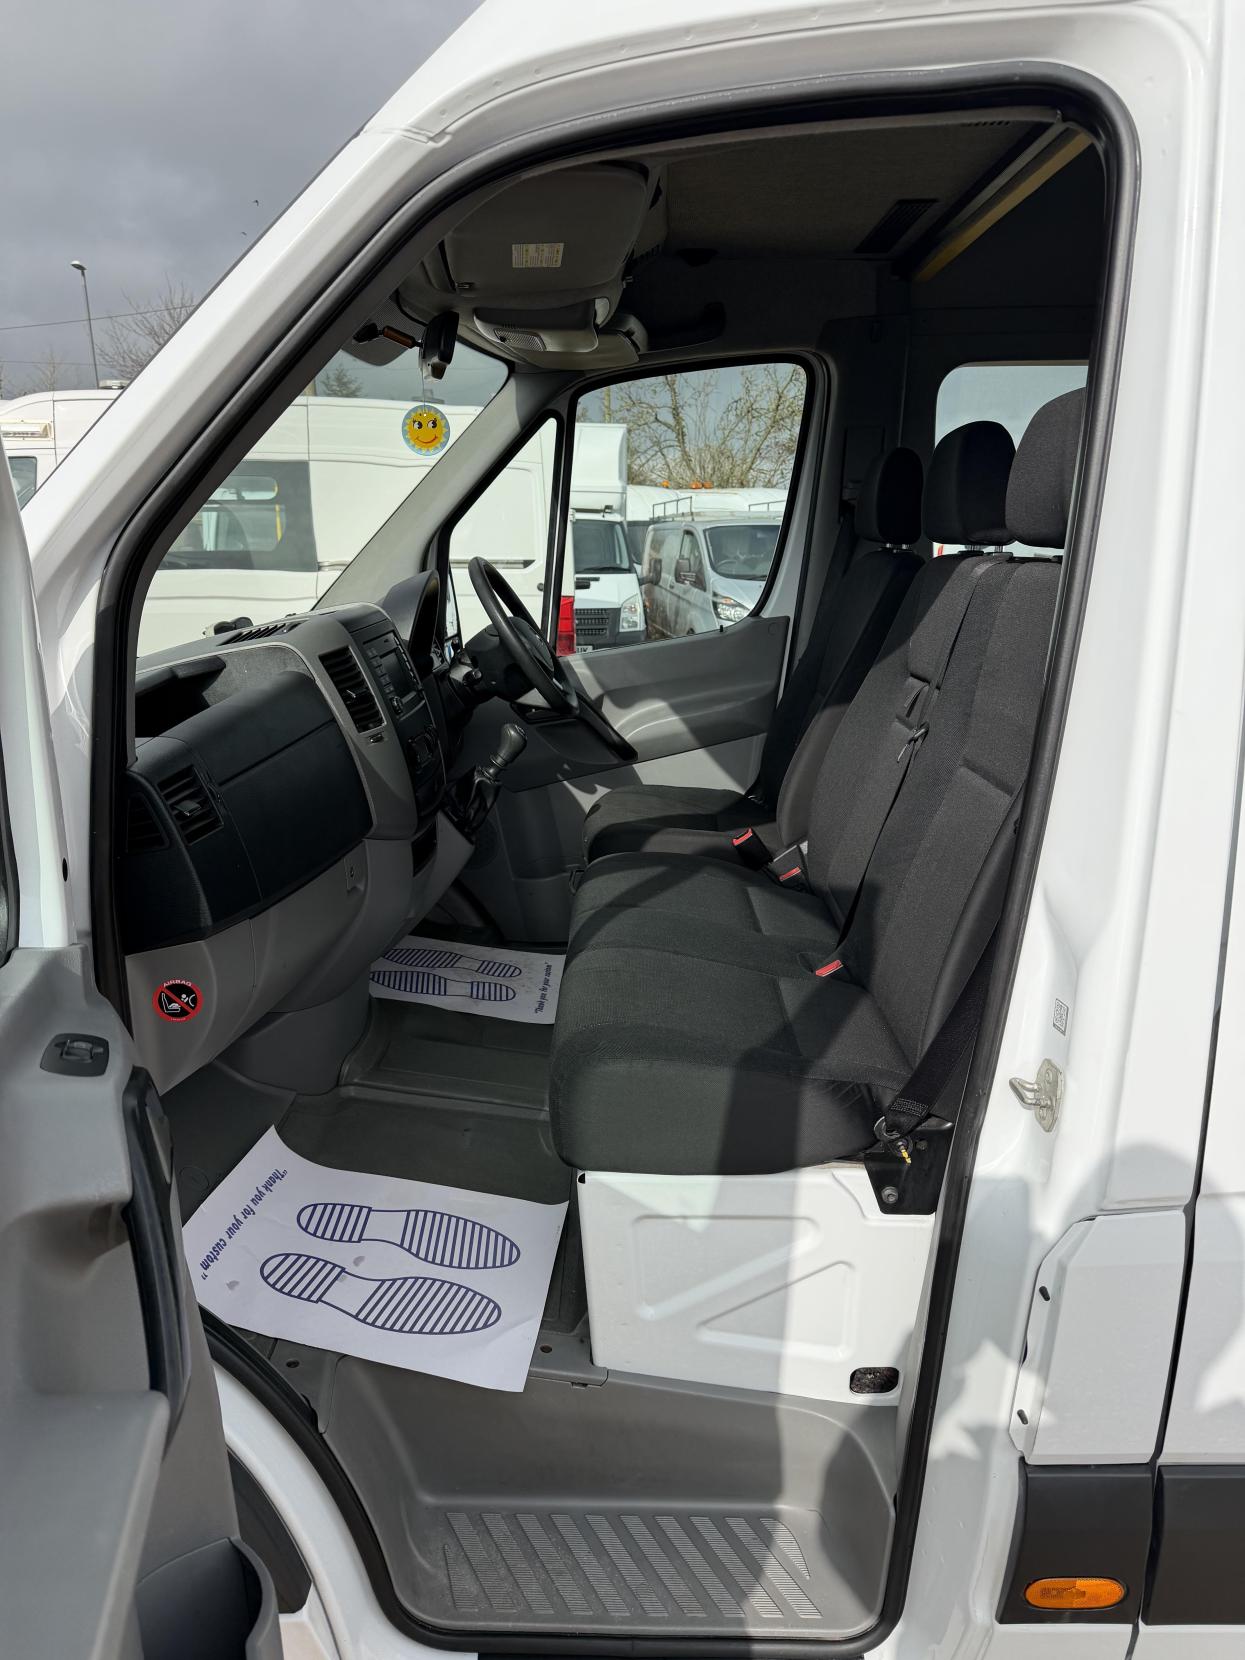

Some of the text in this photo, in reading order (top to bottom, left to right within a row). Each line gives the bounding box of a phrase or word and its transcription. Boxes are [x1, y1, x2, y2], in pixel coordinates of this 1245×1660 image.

[163, 979, 192, 988] AIRBAG
[250, 1186, 267, 1206] you
[240, 1204, 256, 1220] for
[225, 1214, 244, 1240] your
